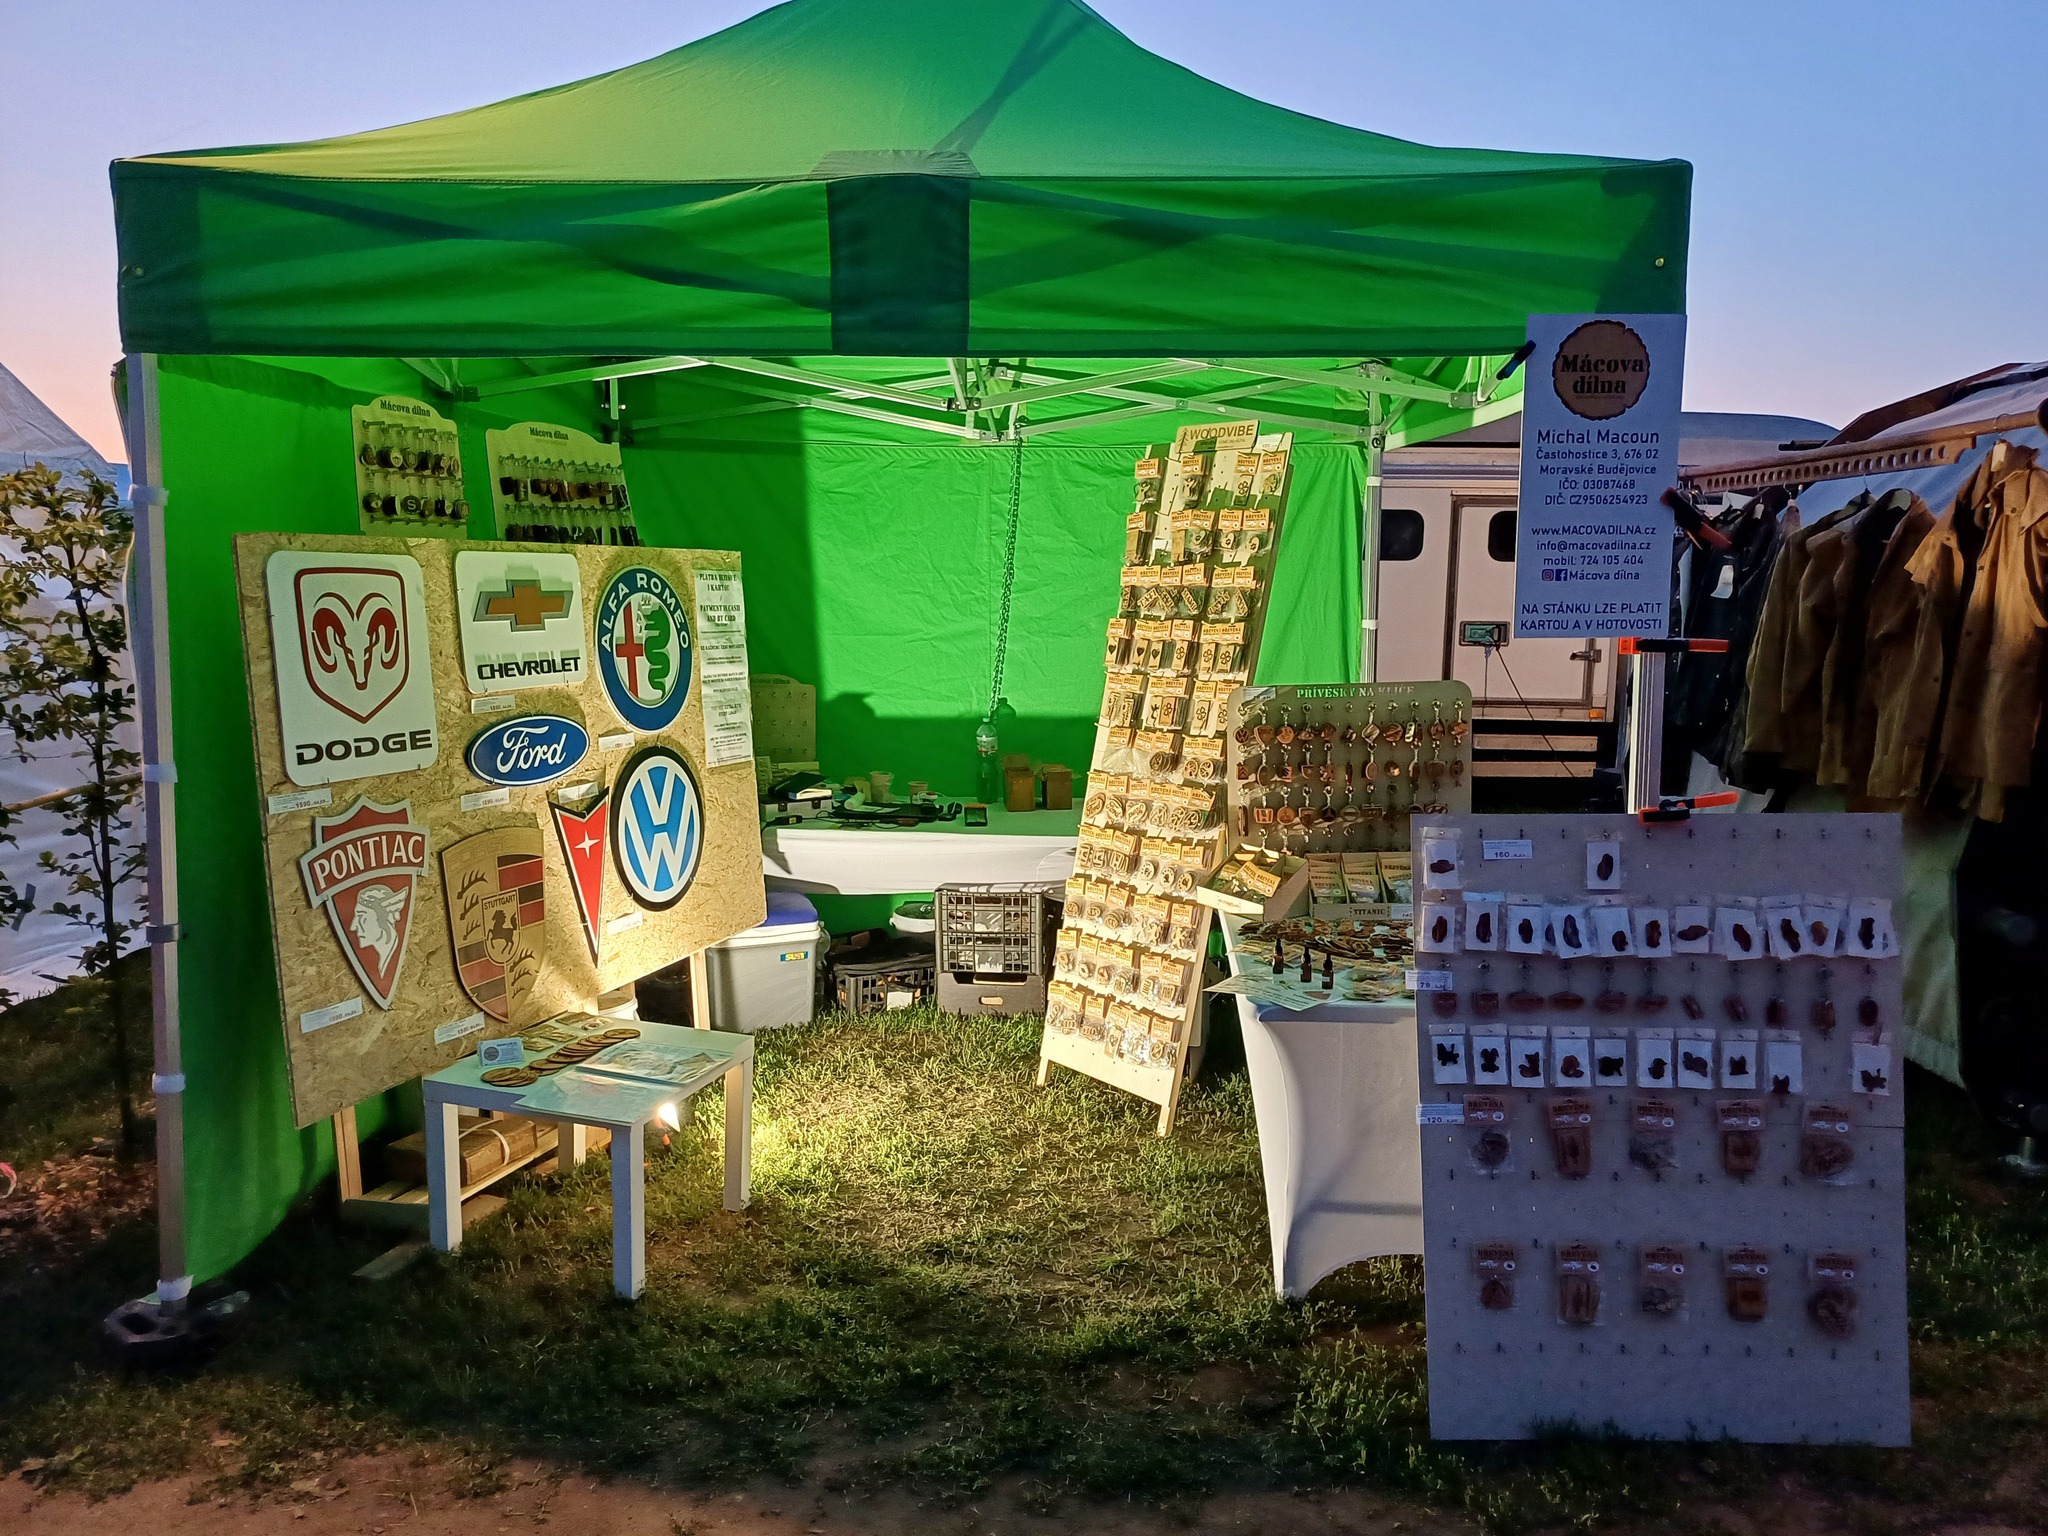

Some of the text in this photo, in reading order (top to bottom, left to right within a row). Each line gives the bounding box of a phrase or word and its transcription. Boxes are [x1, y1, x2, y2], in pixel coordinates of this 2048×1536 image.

[1560, 354, 1644, 373] Mácova
[1572, 376, 1626, 394] dílna
[380, 400, 410, 414] Mácova
[1190, 424, 1254, 440] WOODVIBE
[1537, 429, 1659, 444] Michal Macoun
[1536, 447, 1658, 460] Častohostice 3, 676 02
[1539, 463, 1657, 476] Moravské Budějovice
[1559, 477, 1635, 490] IČO: 03087468
[1545, 492, 1648, 505] DIČ: CZ9506254923
[1531, 525, 1656, 535] www.MACOVADILNA.cz
[1537, 540, 1651, 552] info@macovadilna.cz
[1543, 555, 1643, 566] mobil: 724 105 404
[1570, 569, 1640, 580] Mácova dílna
[601, 573, 689, 652] ALFA ROMEO
[1521, 601, 1662, 614] NA STÁNKU LZE PLATIT
[1521, 619, 1662, 630] KARTOU A V HOTOVOSTI
[477, 657, 580, 680] CHEVROLET
[1297, 685, 1355, 698] PŘÍVĚSKY
[1359, 687, 1374, 697] NA
[295, 729, 433, 766] DODGE
[497, 725, 567, 774] Ford
[313, 834, 423, 889] PONTIAC
[484, 894, 515, 910] STUTTGART
